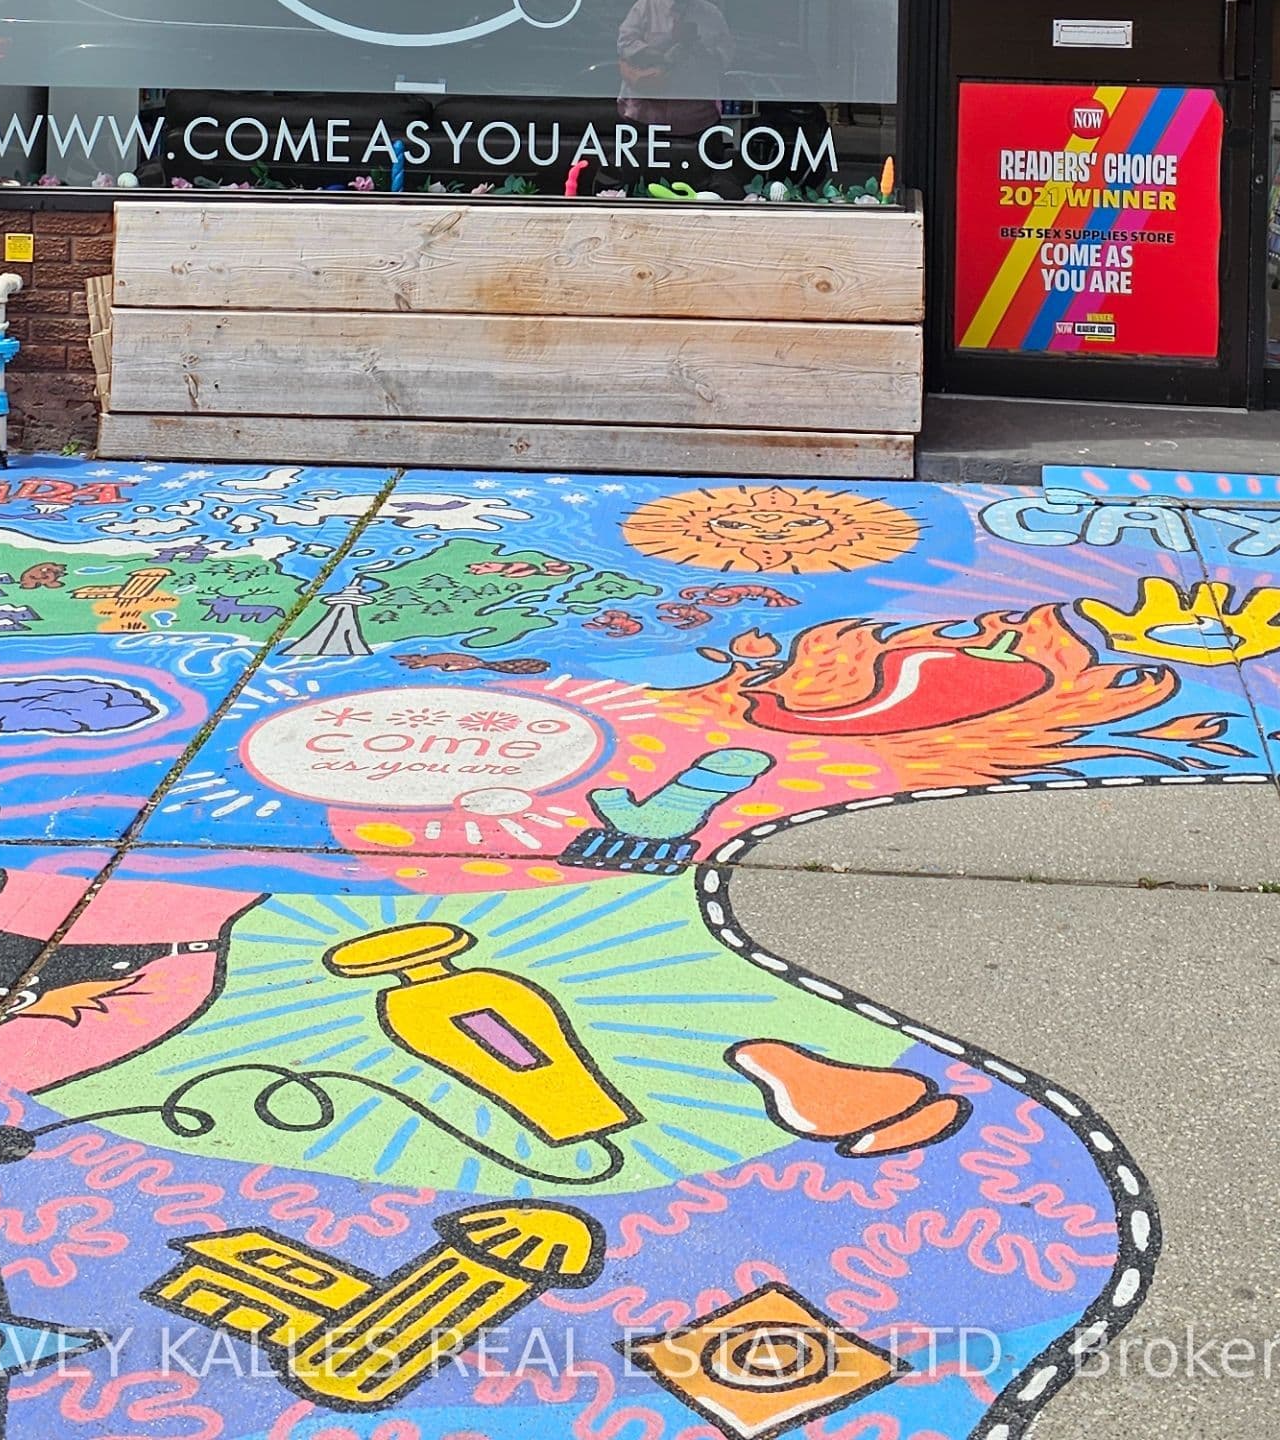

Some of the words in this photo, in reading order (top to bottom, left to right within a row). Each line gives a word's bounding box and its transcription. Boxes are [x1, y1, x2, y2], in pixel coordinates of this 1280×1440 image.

[1073, 109, 1104, 129] NOW
[1000, 150, 1098, 183] READERS'
[1103, 152, 1178, 185] CHOICE
[999, 185, 1058, 208] 2021
[1065, 187, 1177, 211] WINNER
[1000, 227, 1035, 239] BEST
[1036, 228, 1062, 239] SEX
[1065, 229, 1128, 242] SUPPLIES
[1130, 231, 1175, 244] STORE
[1040, 243, 1102, 268] COME
[1106, 245, 1134, 268] AS
[1041, 269, 1086, 293] YOU
[1089, 271, 1133, 295] ARE
[306, 731, 543, 760] come
[311, 758, 363, 774] as
[366, 760, 459, 780] you
[458, 761, 522, 775] are
